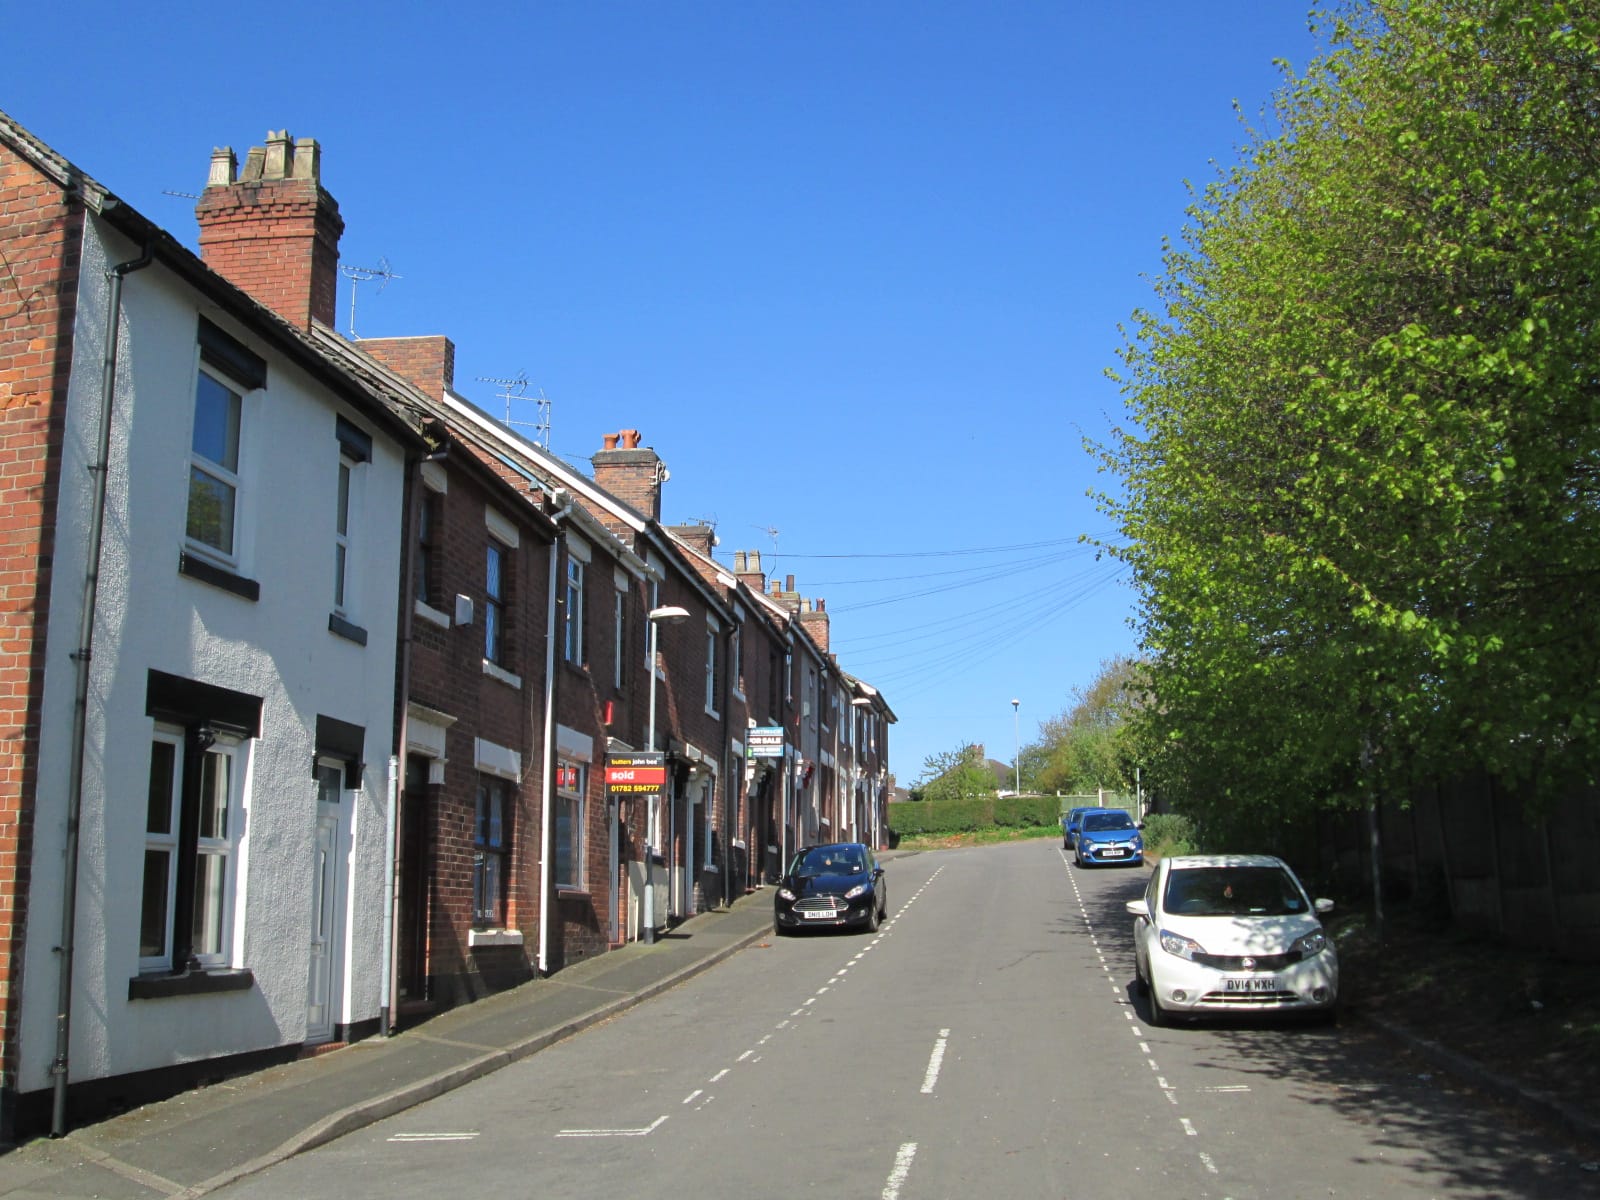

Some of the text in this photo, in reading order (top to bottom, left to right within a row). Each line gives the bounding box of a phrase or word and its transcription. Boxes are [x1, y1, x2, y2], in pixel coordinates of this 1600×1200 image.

[762, 737, 781, 745] SALE
[611, 758, 632, 766] butters
[632, 758, 646, 767] john
[646, 758, 658, 766] bee
[611, 770, 635, 780] sold
[1227, 979, 1275, 990] DV14 WXH
